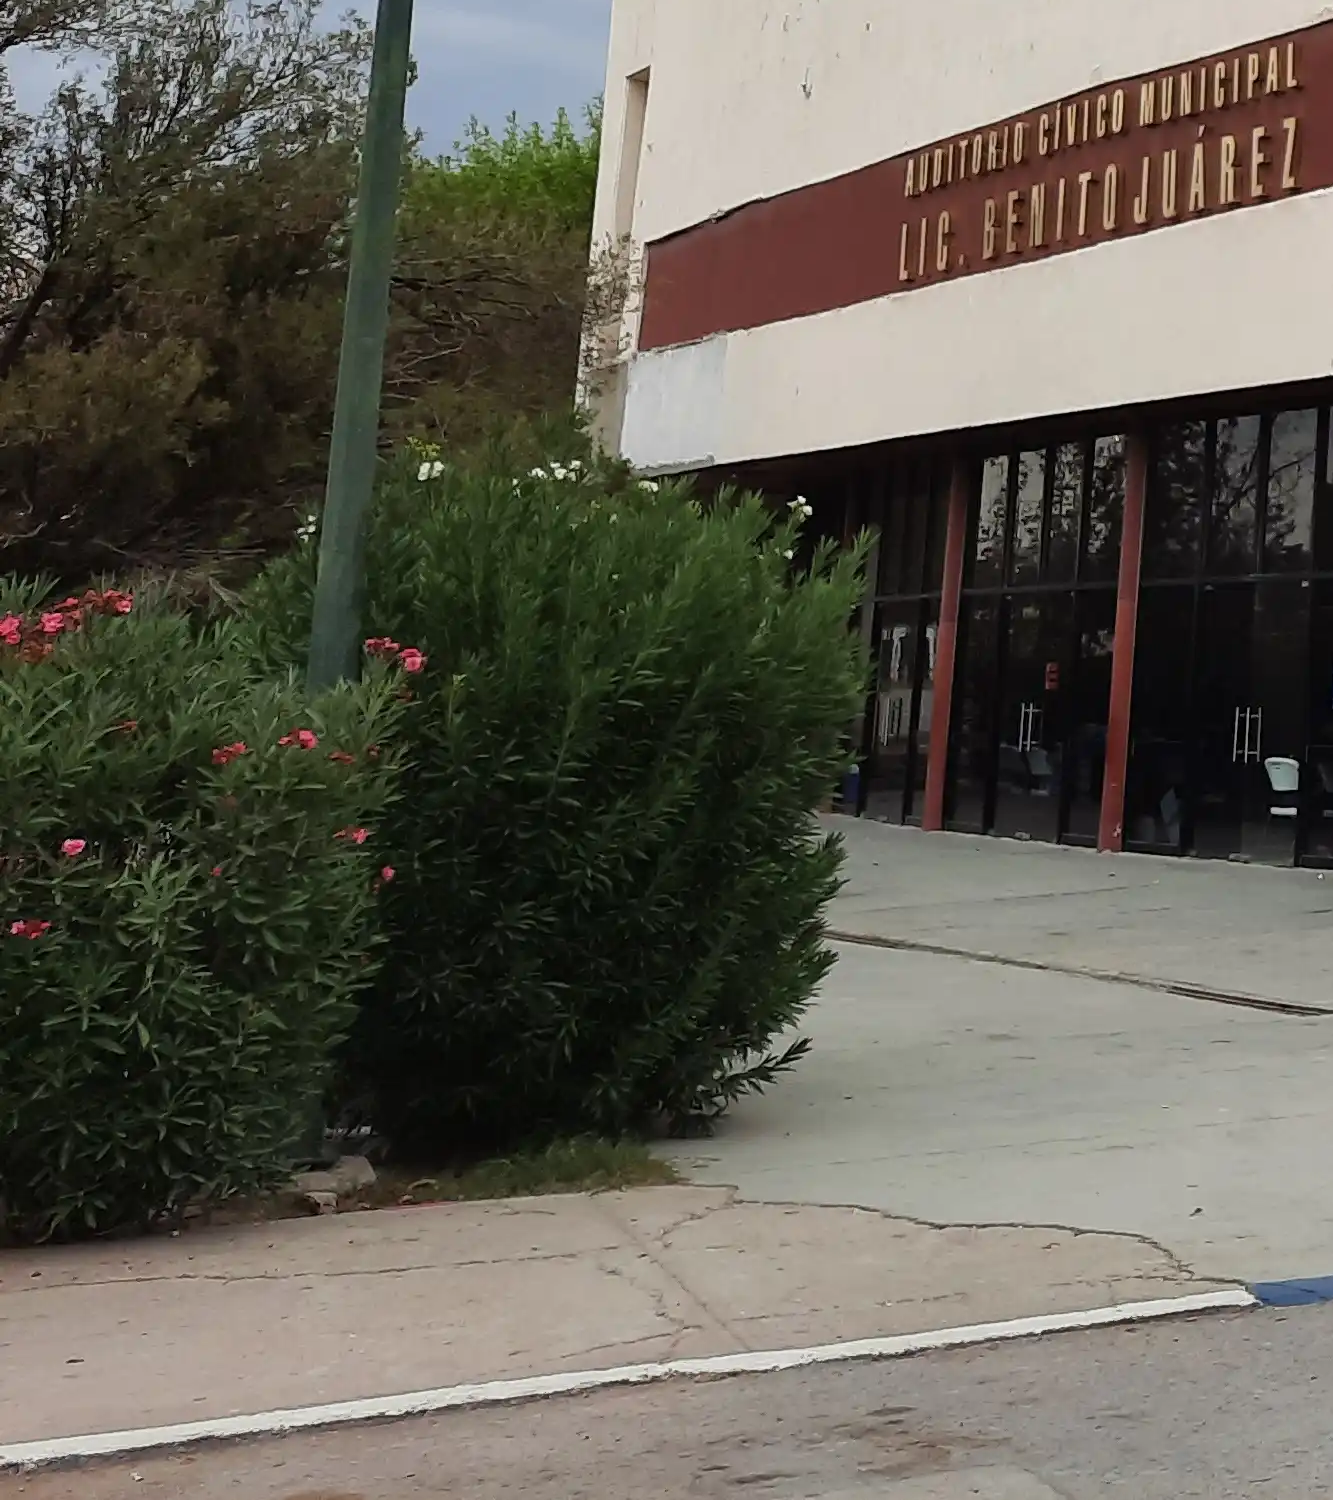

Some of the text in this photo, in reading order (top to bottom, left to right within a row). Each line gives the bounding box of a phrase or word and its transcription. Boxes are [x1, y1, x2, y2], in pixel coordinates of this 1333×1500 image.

[899, 117, 1297, 281] LIC. BENITO JUÁREZ
[904, 41, 1298, 197] AUDITORIO CÍVICO MUNICIPAL
